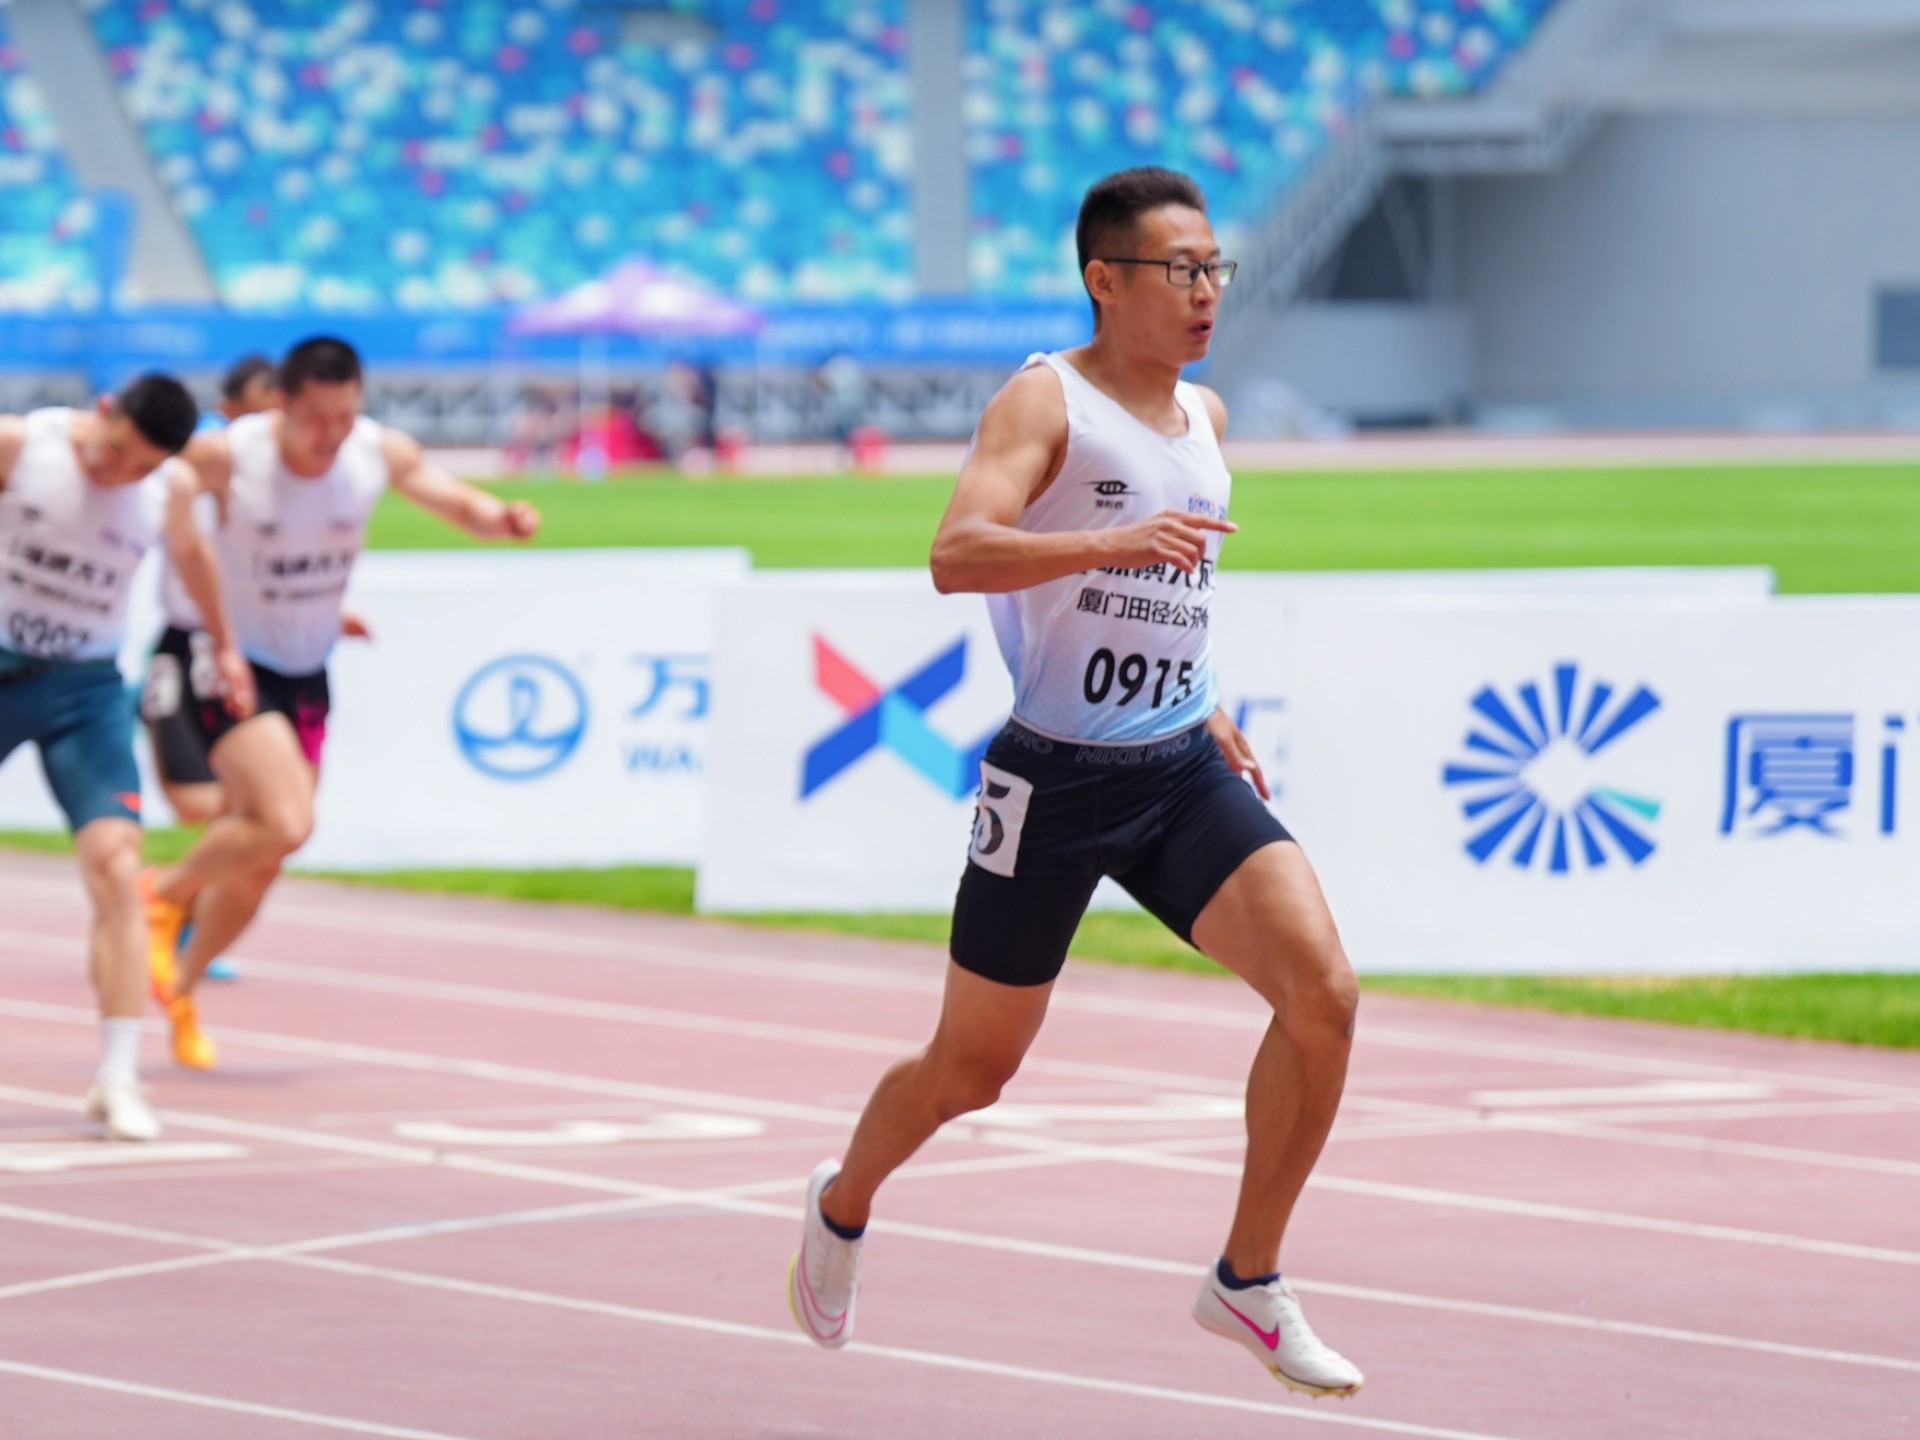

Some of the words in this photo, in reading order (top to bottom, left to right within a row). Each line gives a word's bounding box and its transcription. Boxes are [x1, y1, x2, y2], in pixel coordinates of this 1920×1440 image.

[1083, 647, 1192, 709] 0915
[1074, 743, 1143, 765] NIKE
[1145, 731, 1192, 763] PRO
[974, 778, 1011, 855] 5
